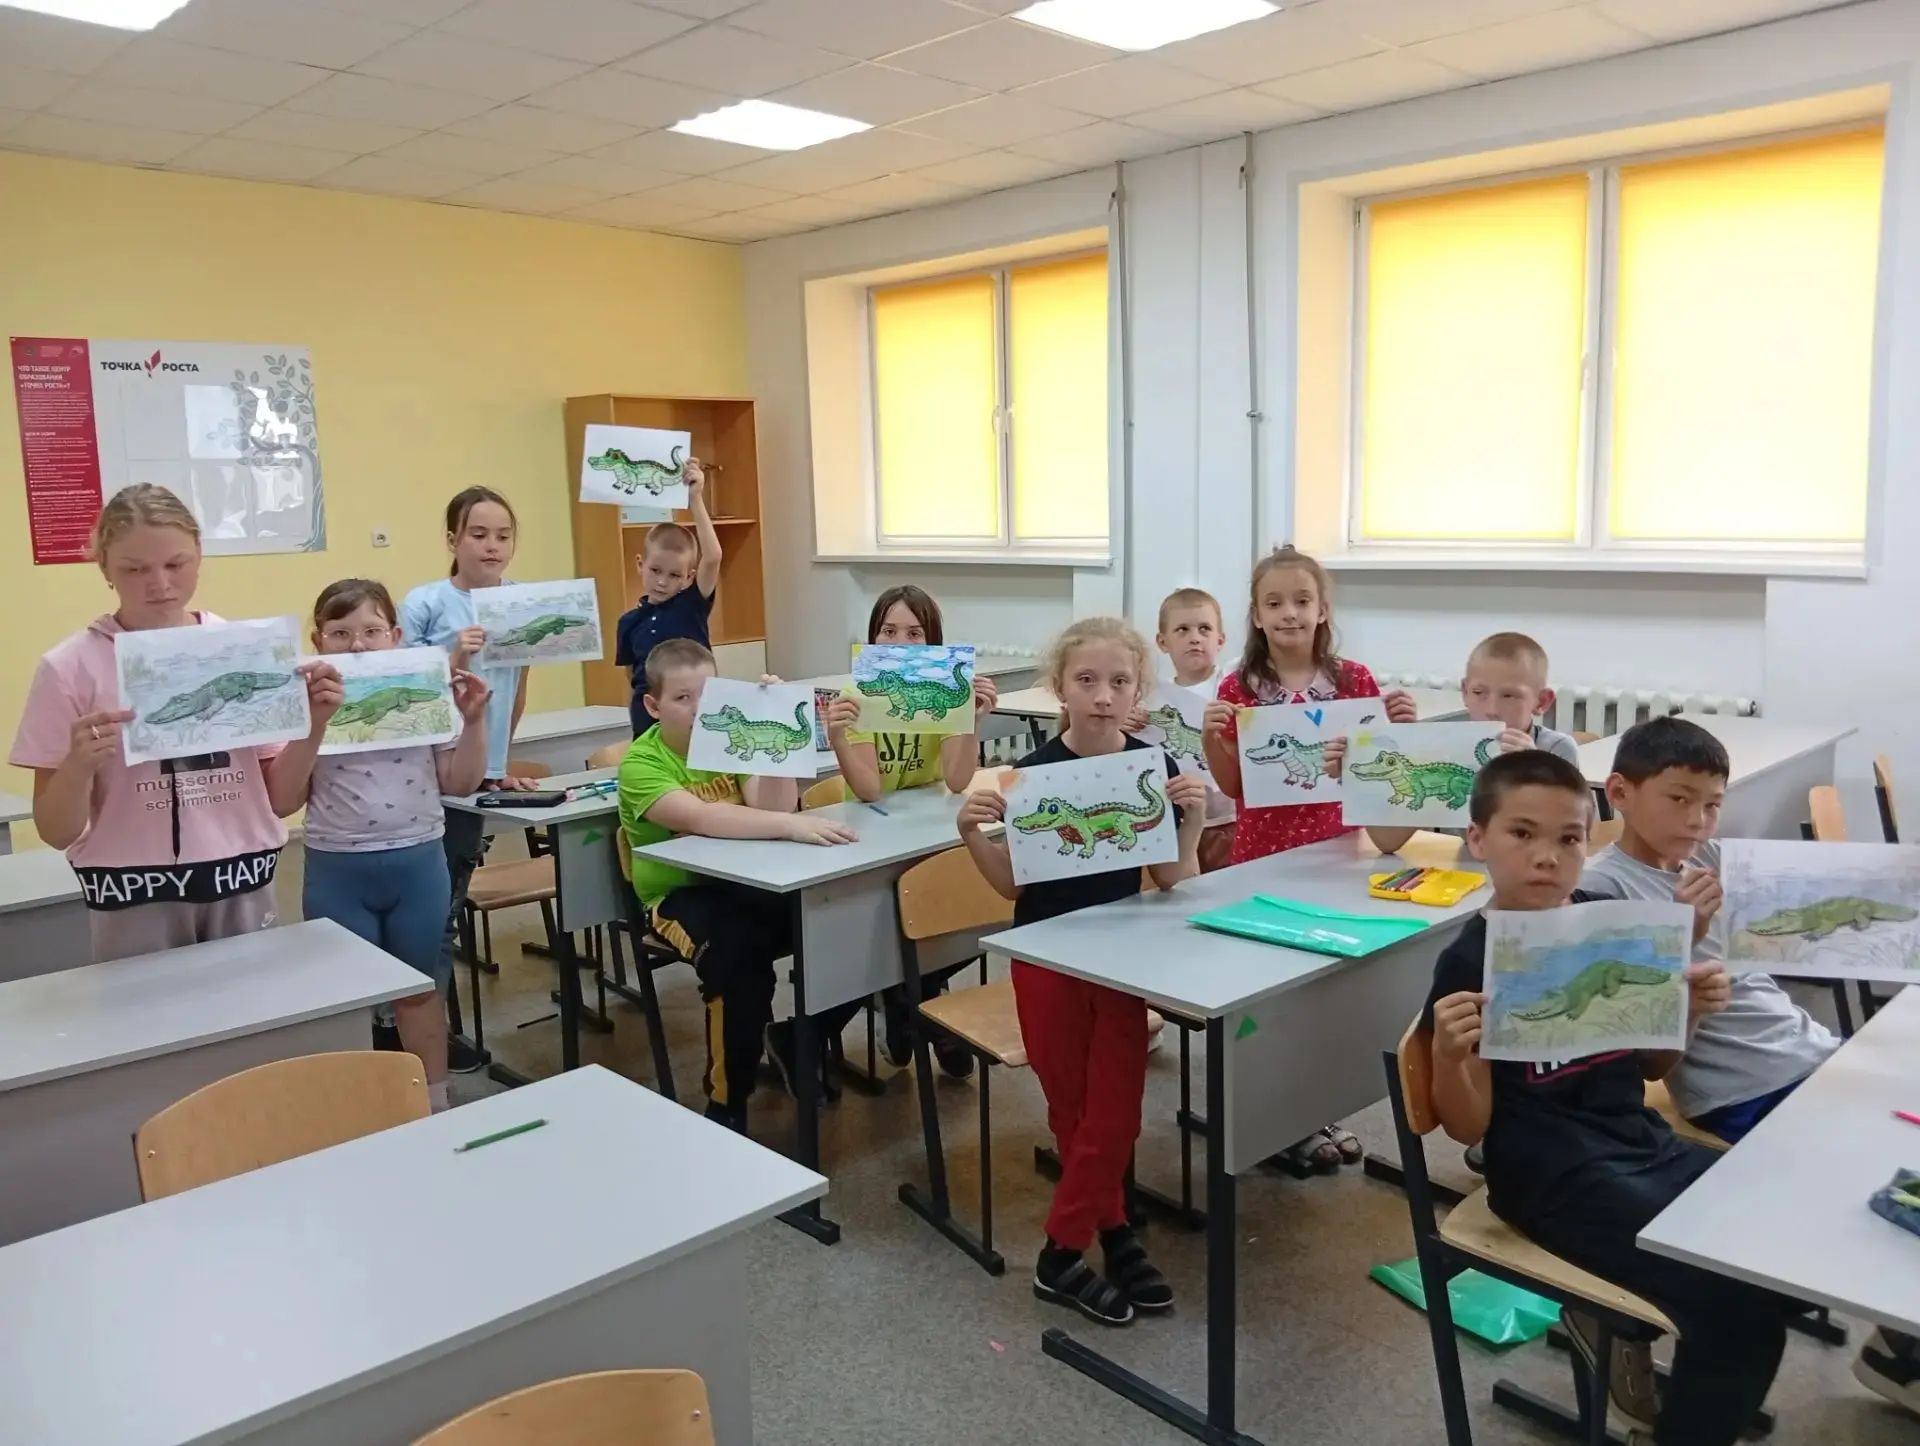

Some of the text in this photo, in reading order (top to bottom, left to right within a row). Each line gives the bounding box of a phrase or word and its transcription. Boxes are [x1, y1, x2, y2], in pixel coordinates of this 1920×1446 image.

[100, 361, 199, 372] ТОЧКА РОСТА
[79, 869, 193, 904] HAPPY
